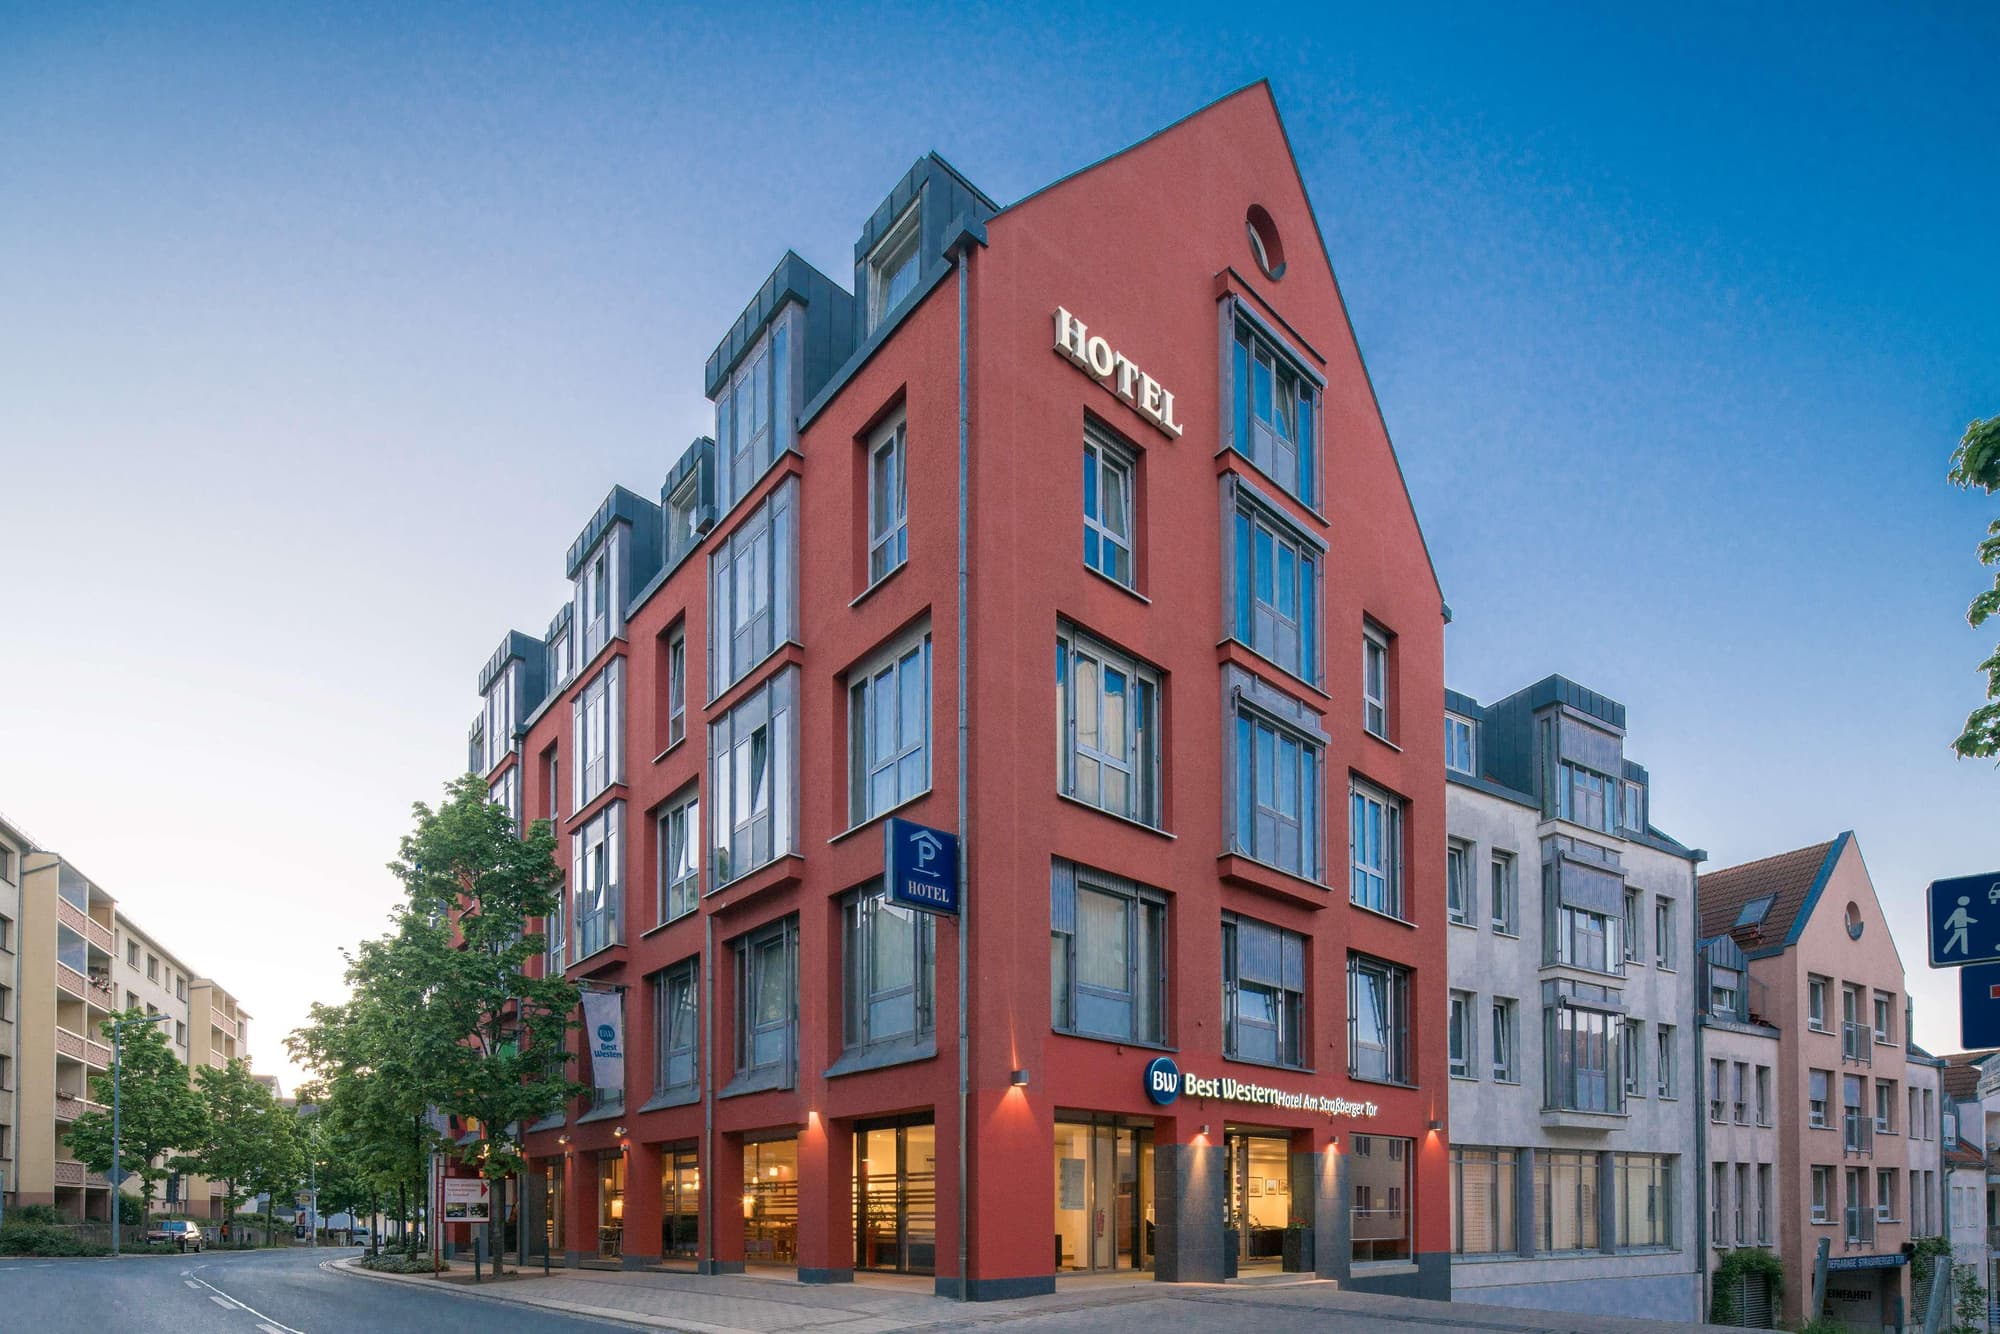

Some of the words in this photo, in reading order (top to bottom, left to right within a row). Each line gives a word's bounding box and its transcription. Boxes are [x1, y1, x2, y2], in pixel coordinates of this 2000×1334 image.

[1053, 305, 1183, 438] HOTEL
[918, 840, 936, 867] P
[908, 880, 949, 903] HOTEL
[1153, 1070, 1178, 1093] BW
[1185, 1072, 1220, 1098] Best
[1222, 1078, 1280, 1105] Western
[1279, 1090, 1302, 1109] Hotel
[1303, 1094, 1318, 1110] Am
[1319, 1096, 1364, 1117] Straßberger
[1365, 1101, 1378, 1116] Tor
[1827, 1288, 1873, 1300] EINFAHRT
